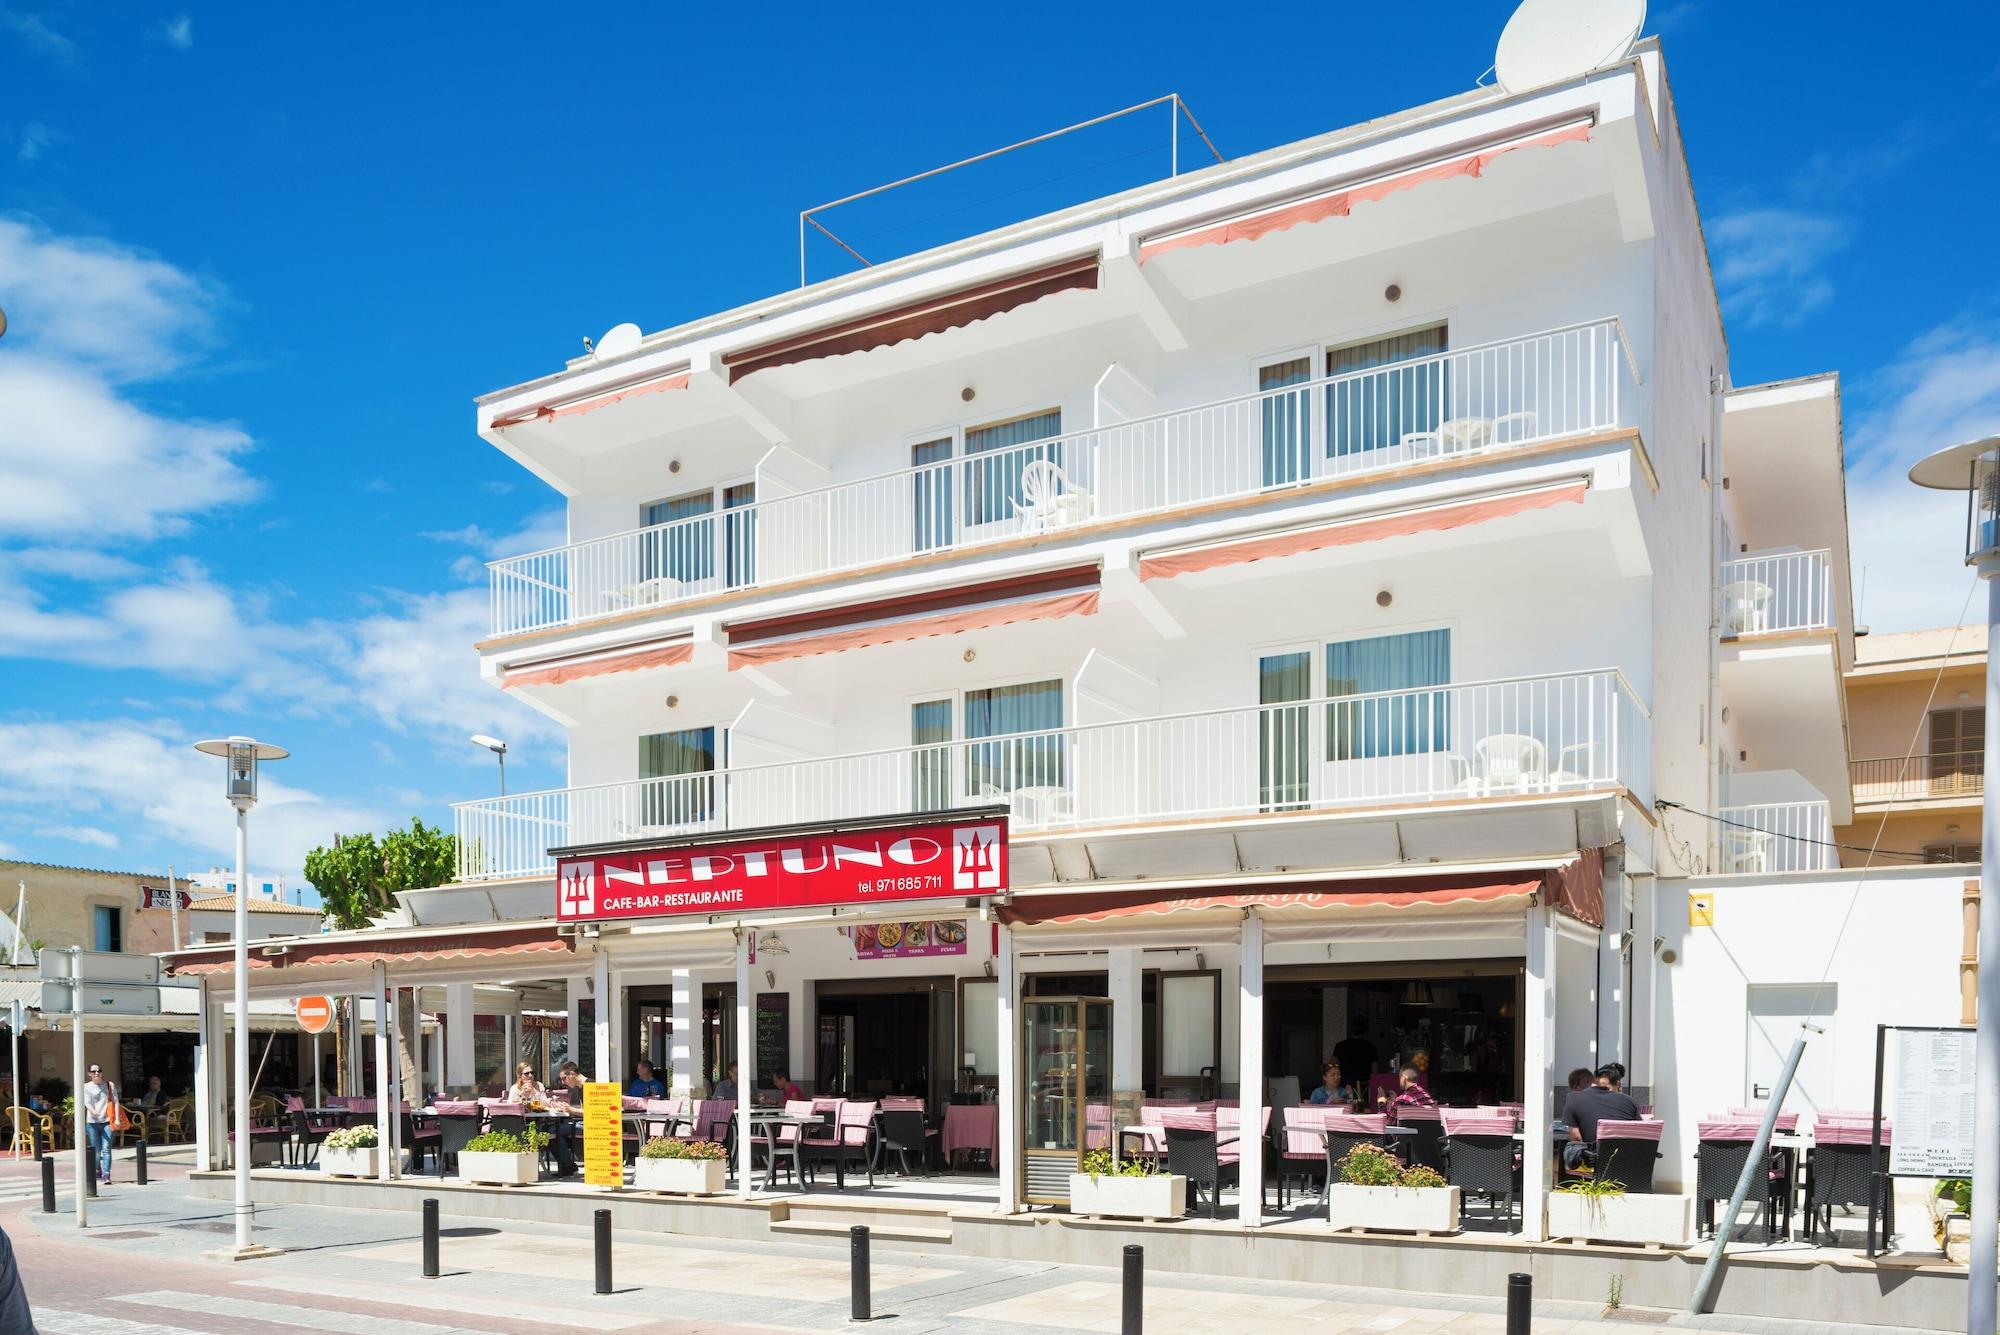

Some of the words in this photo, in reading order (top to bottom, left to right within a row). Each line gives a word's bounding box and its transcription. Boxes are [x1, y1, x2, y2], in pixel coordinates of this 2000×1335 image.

[603, 837, 942, 888] NEPTUNO
[857, 880, 875, 894] tel.
[924, 874, 942, 888] 711
[152, 890, 183, 899] BLANO
[157, 899, 182, 908] NEGO
[603, 889, 743, 911] CAFE-BAR-RESTAURANTE
